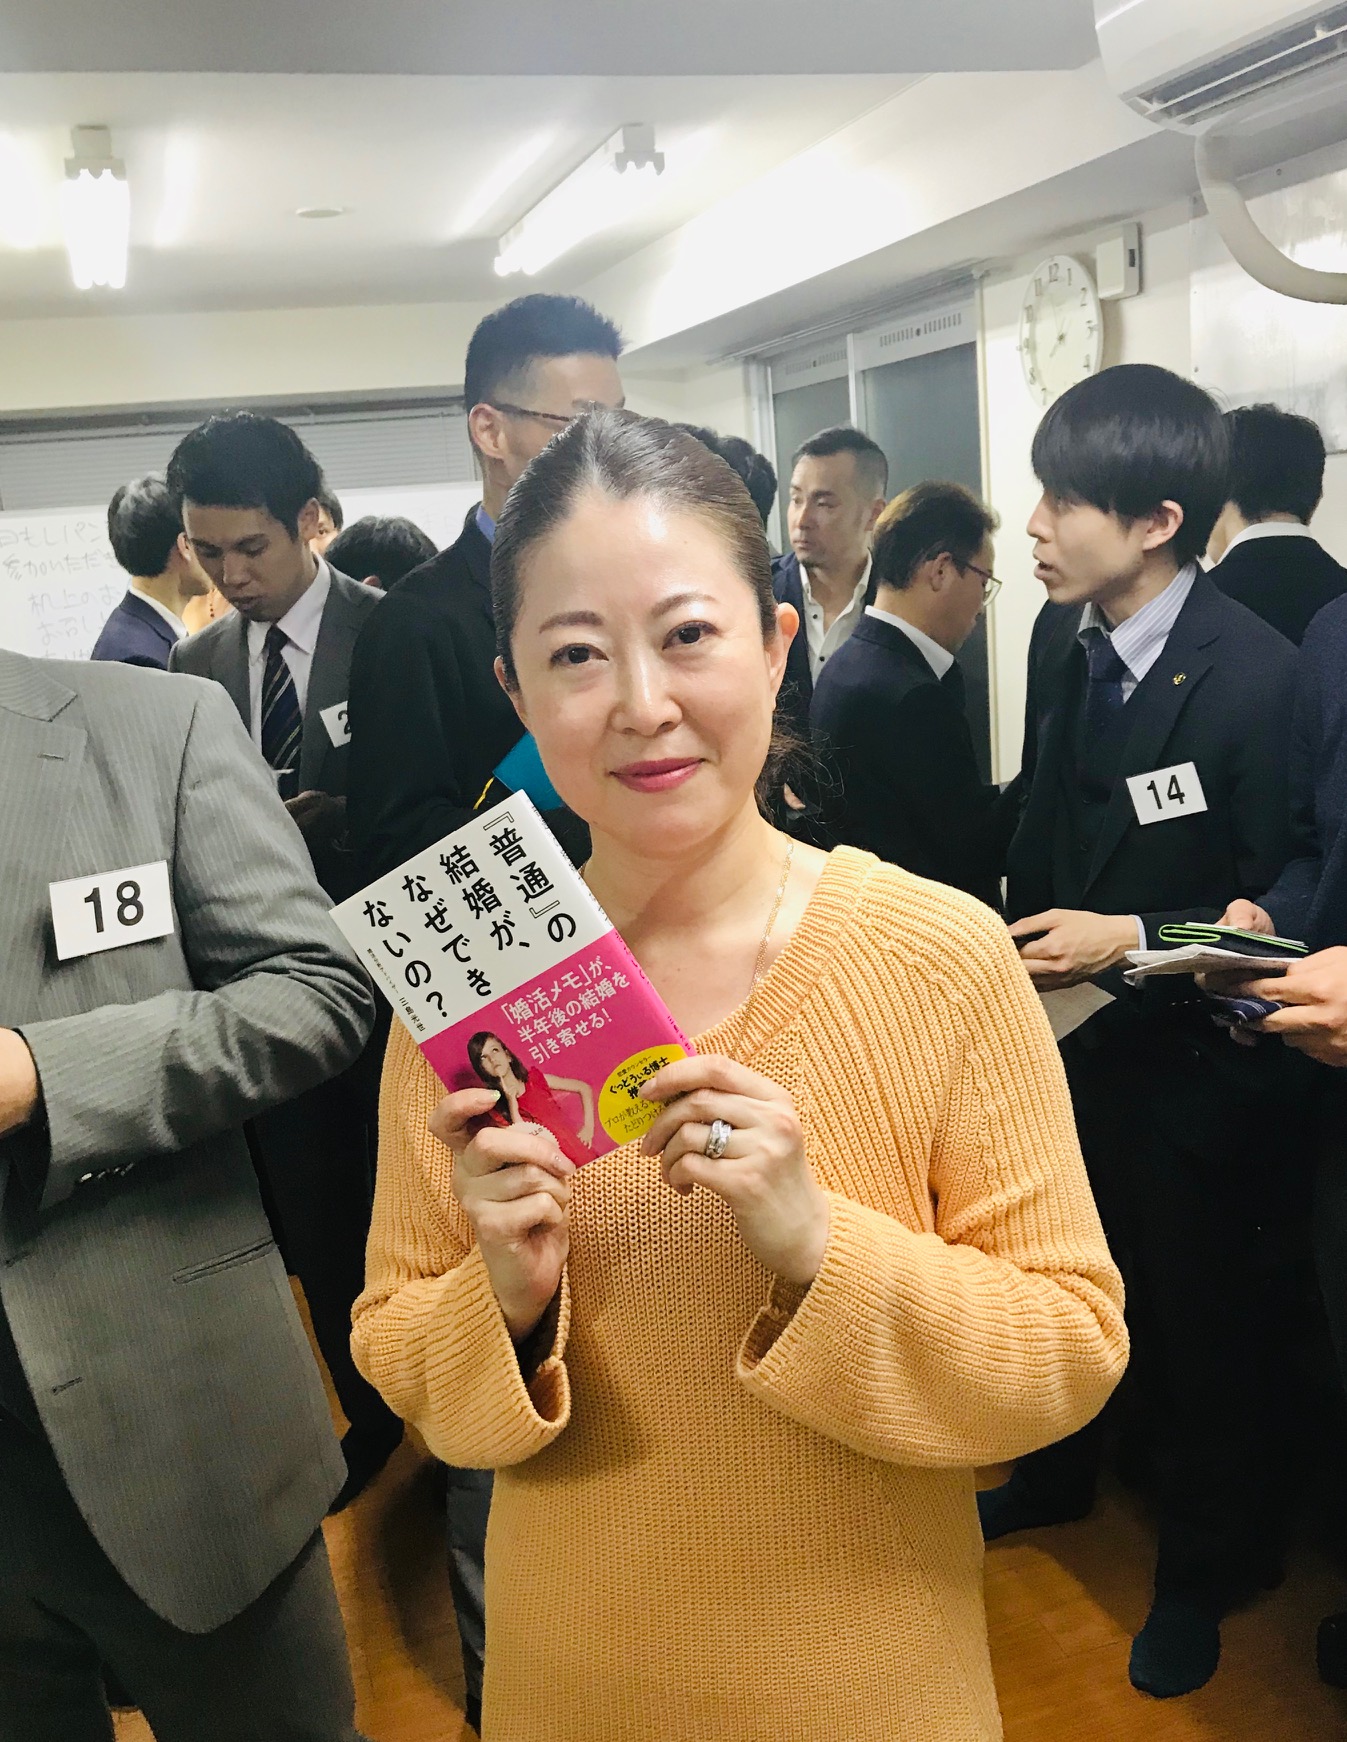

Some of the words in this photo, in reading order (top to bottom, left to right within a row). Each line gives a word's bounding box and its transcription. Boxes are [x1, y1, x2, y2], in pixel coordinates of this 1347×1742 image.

[1147, 774, 1186, 810] 14
[84, 880, 144, 933] 18
[483, 811, 577, 943] 『普通』の
[402, 874, 493, 997] なぜでき
[517, 969, 631, 1045] 半年後の結婚を
